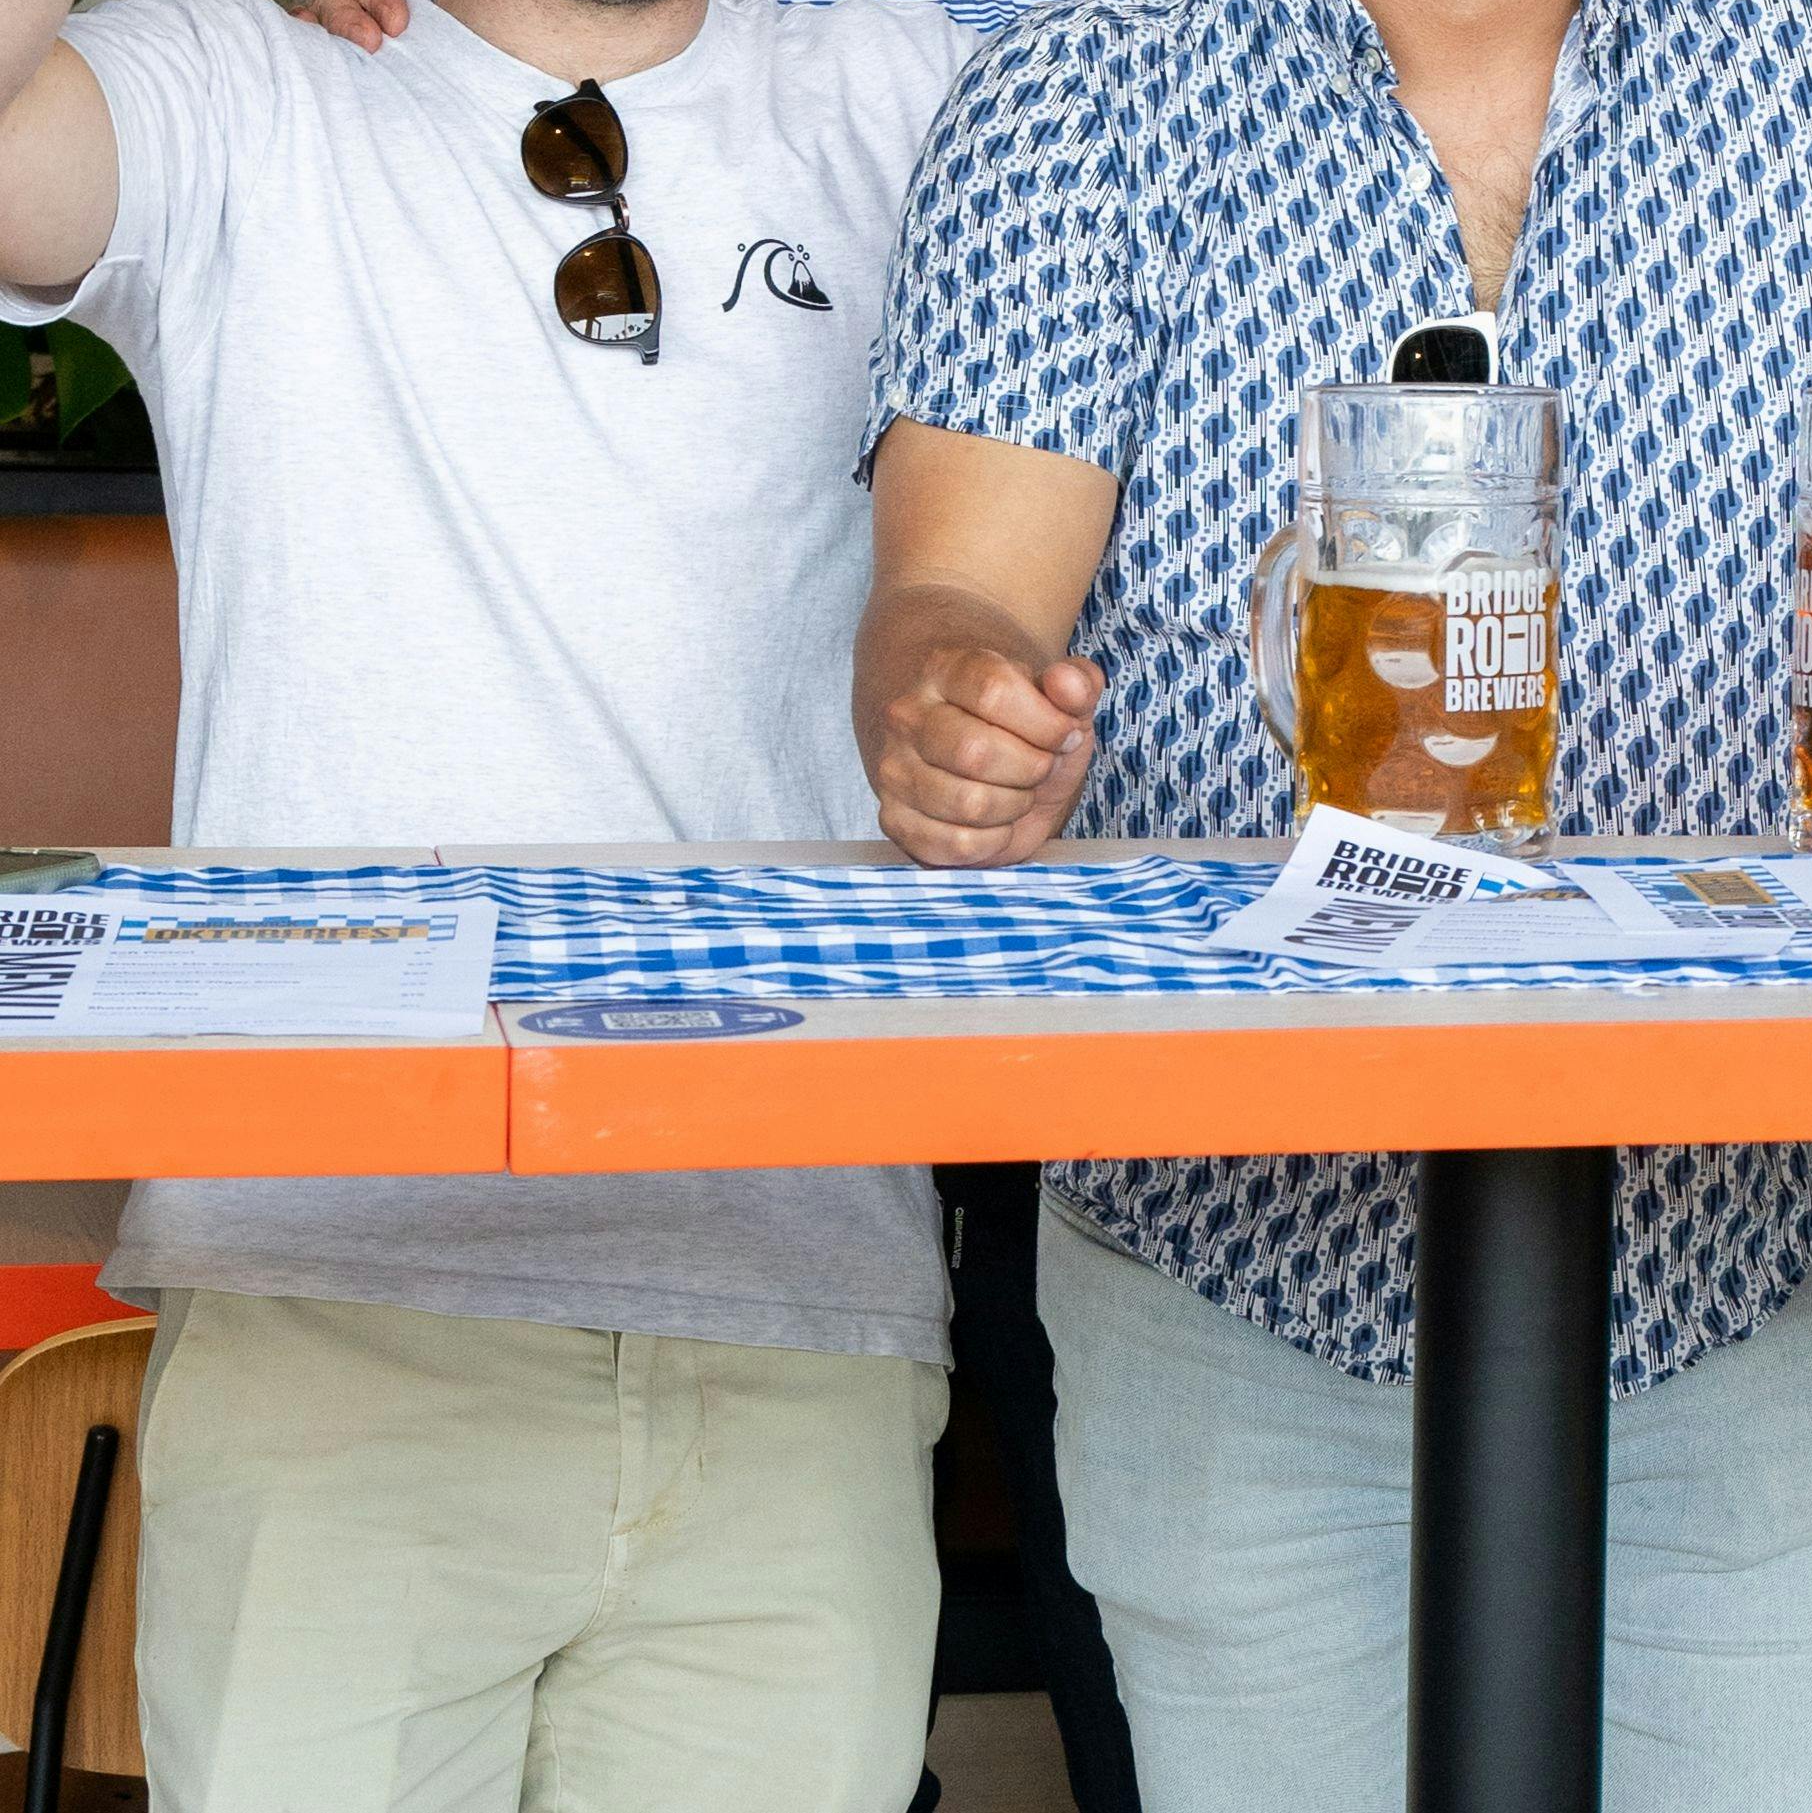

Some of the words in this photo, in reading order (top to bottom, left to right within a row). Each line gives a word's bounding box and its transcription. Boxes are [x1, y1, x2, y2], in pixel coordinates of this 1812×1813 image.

[1446, 569, 1547, 616] BRIDGE
[1445, 614, 1547, 678] ROAD
[1445, 674, 1546, 713] BREWERS
[1321, 857, 1464, 900] ROAD
[1333, 840, 1473, 884] BRIDGE
[1315, 877, 1455, 905] BREWERS
[0, 909, 111, 926] RIDGE
[0, 923, 106, 940] OAD
[153, 926, 409, 940] OKTOBERFEST
[1284, 897, 1433, 954] MENU
